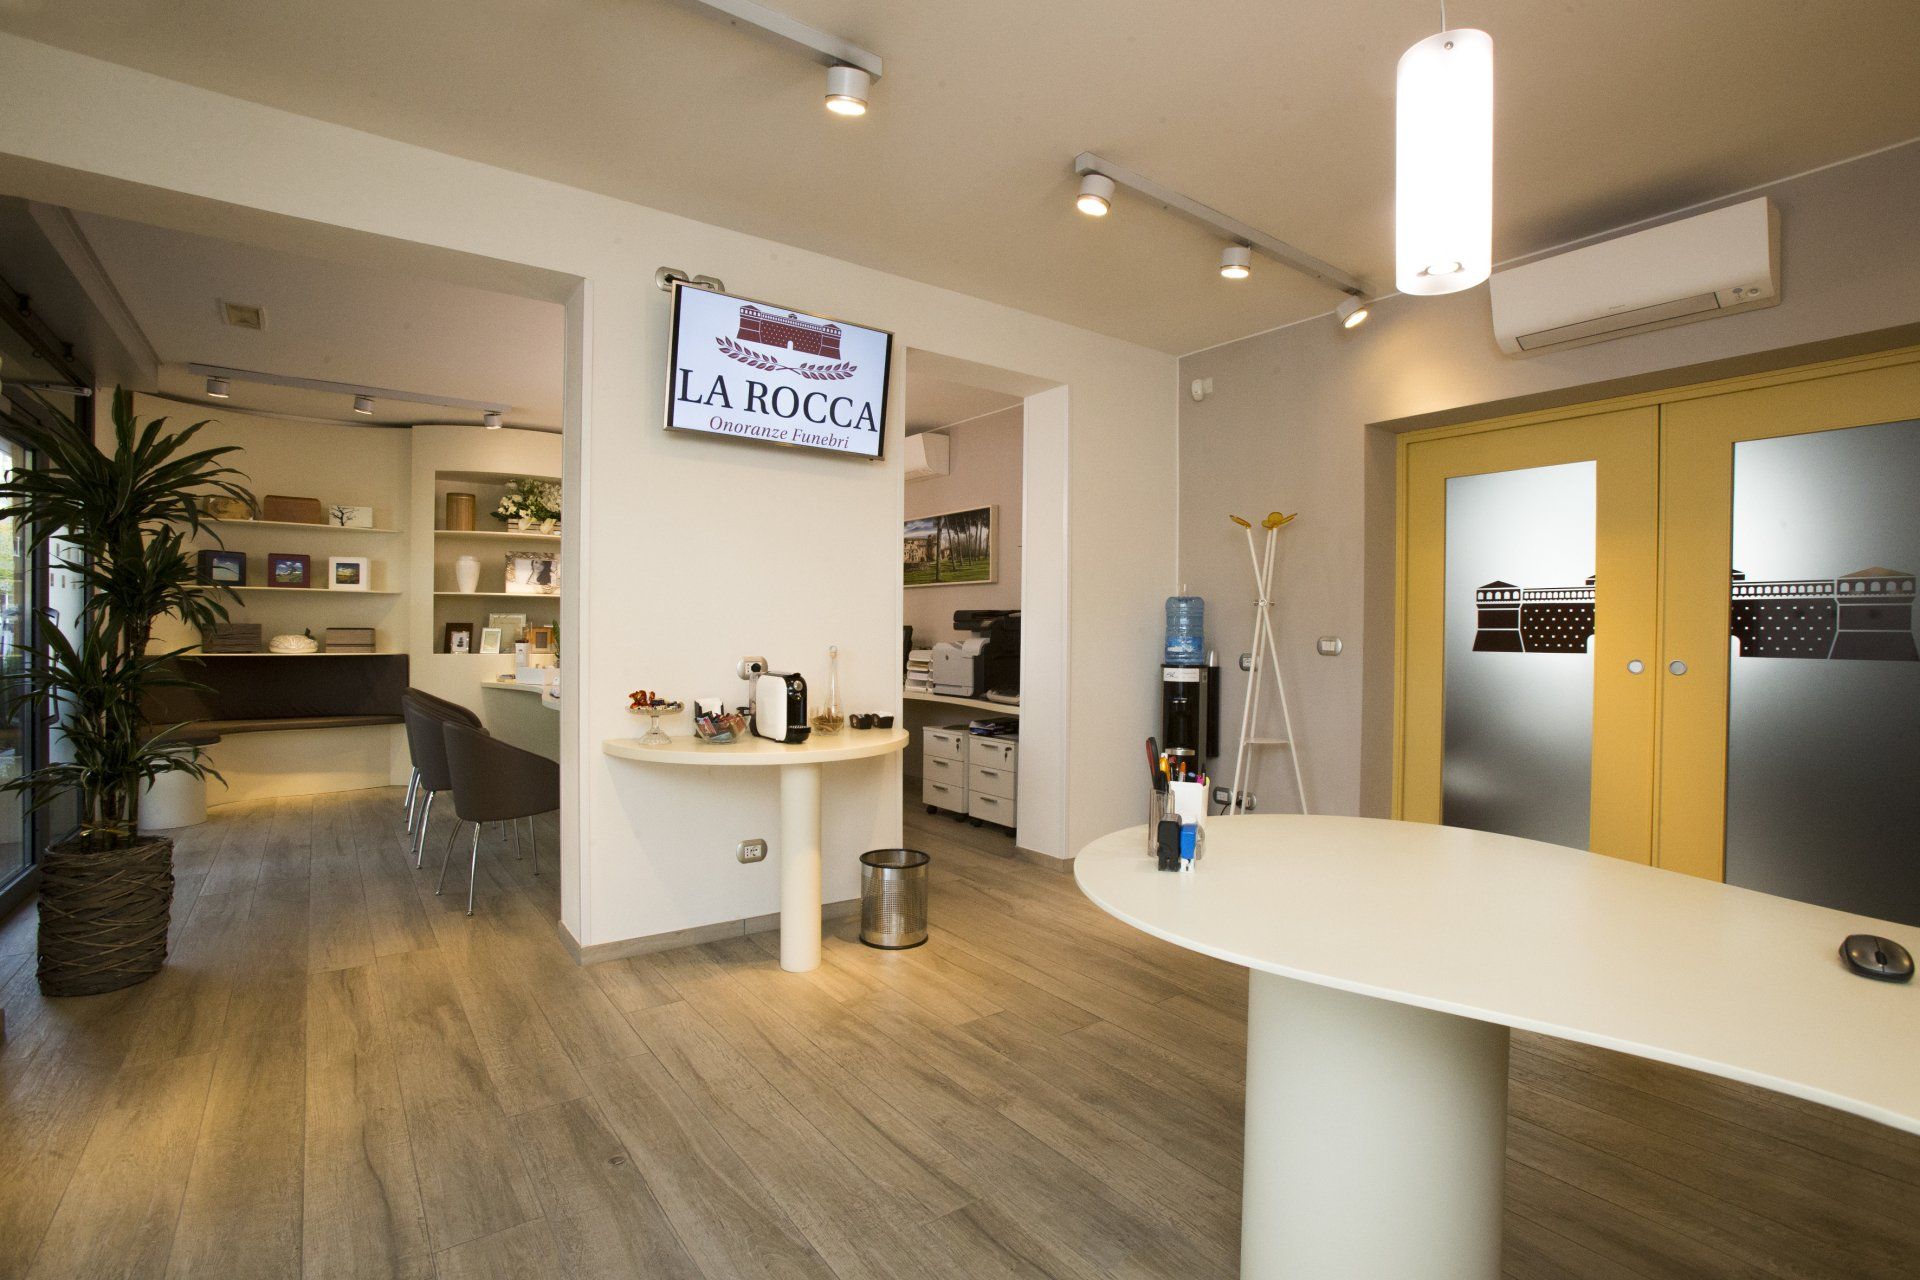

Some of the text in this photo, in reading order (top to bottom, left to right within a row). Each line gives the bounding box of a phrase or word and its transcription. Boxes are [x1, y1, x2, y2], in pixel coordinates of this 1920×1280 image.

[677, 368, 877, 432] LA ROCCA
[709, 415, 849, 449] Onoranze Funebri
